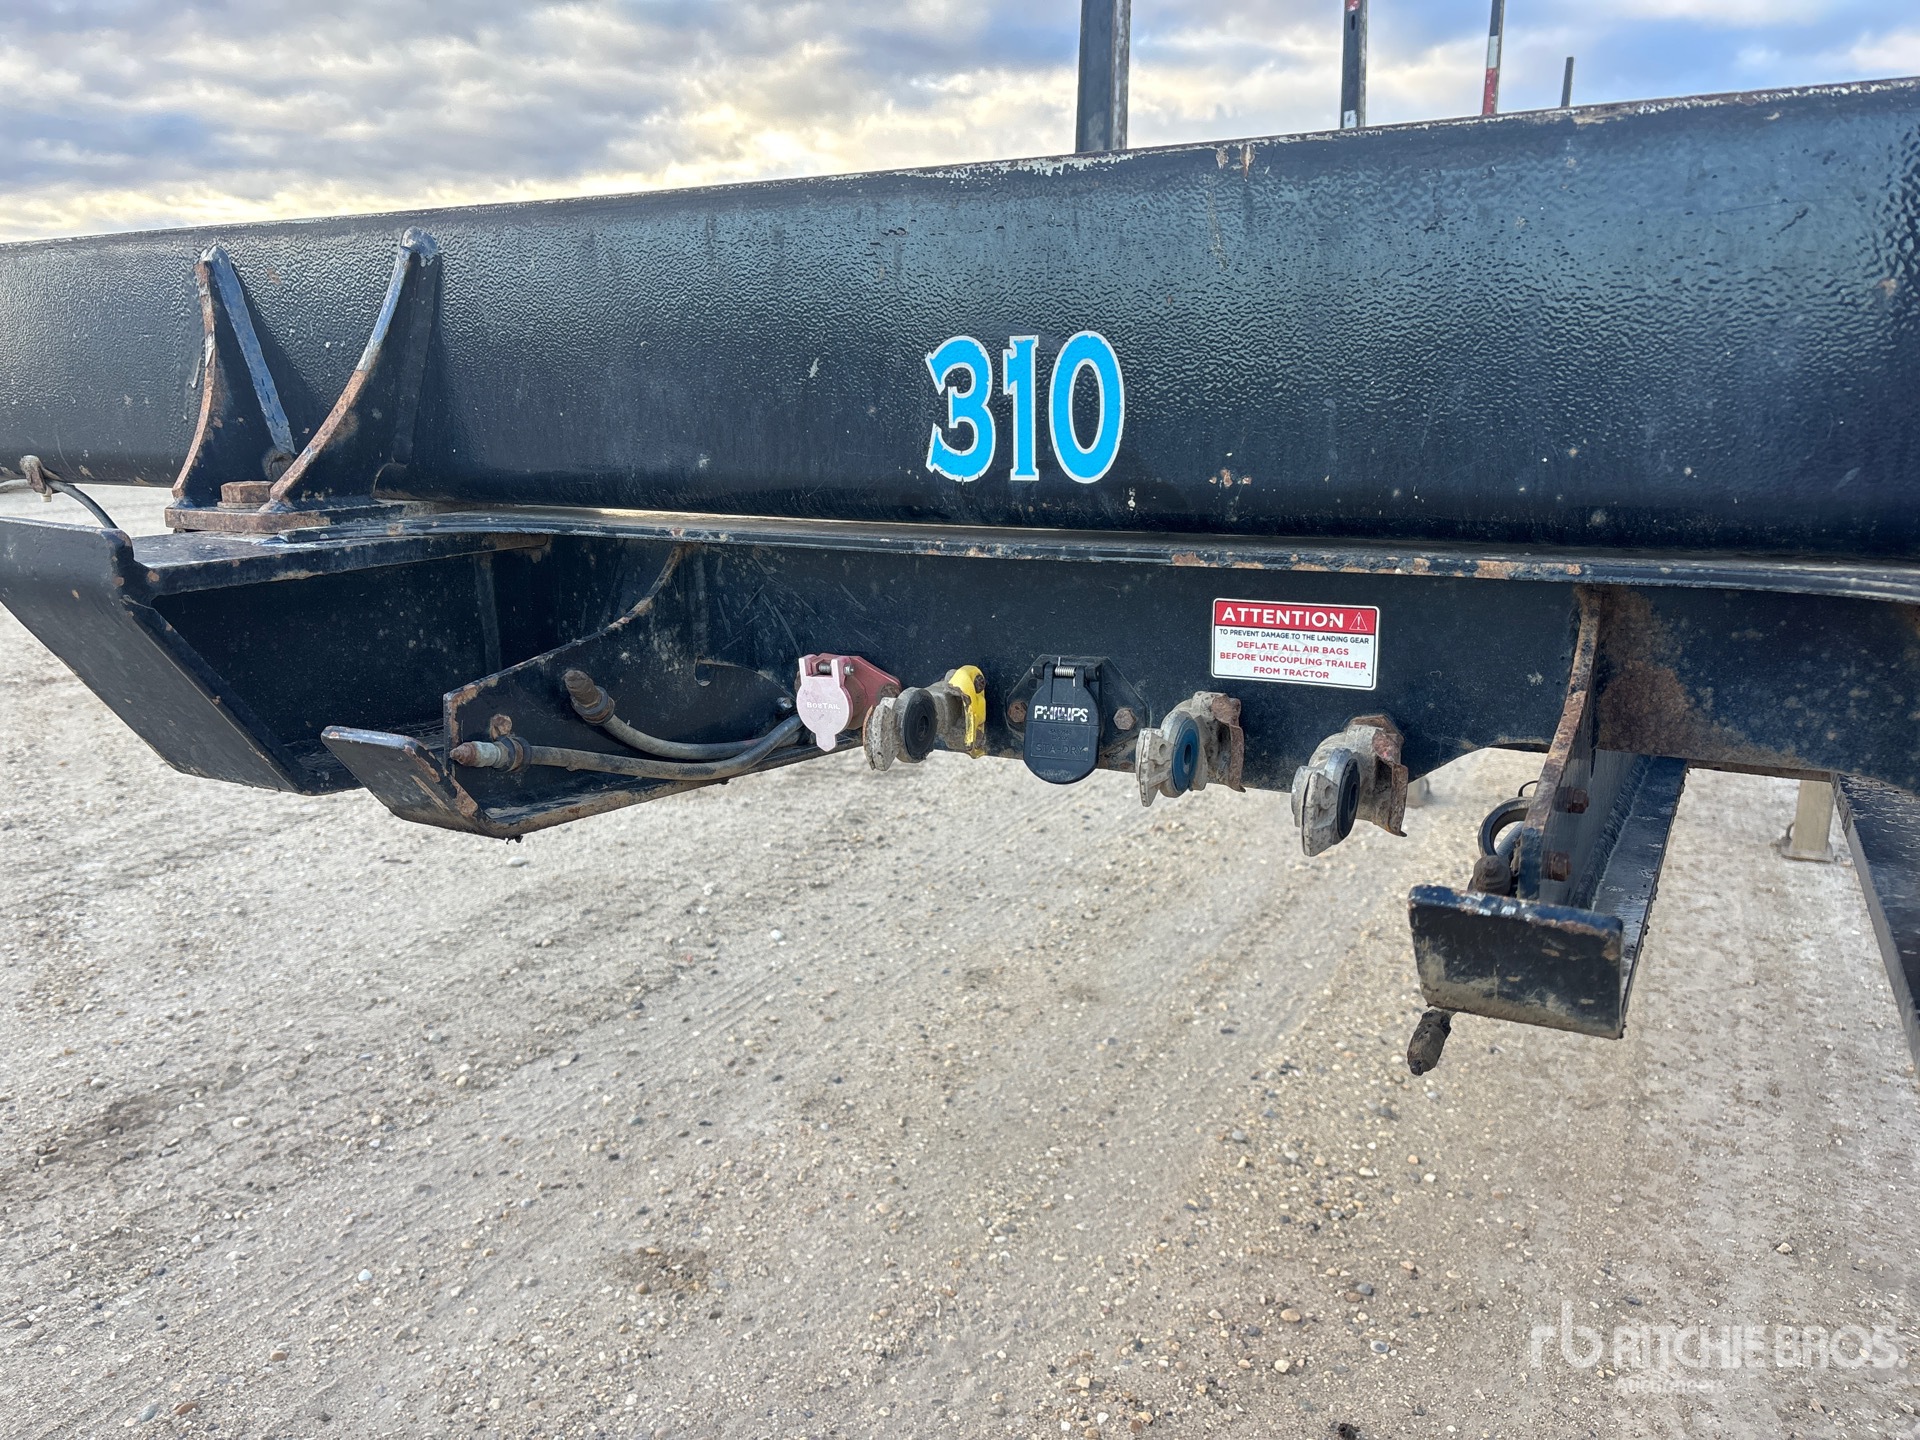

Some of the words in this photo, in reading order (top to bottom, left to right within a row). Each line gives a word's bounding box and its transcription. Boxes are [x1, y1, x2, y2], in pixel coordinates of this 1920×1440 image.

[925, 330, 1125, 485] 310
[1221, 606, 1344, 629] ATTENTION
[1219, 628, 1229, 636] TO
[1229, 629, 1260, 638] PREVENT
[1260, 631, 1290, 640] DAMAGE
[1291, 633, 1301, 641] TO
[1302, 633, 1316, 641] THE
[1316, 635, 1349, 644] LANDING
[1349, 636, 1370, 645] GEAR
[1236, 640, 1279, 651] DEFLATE
[1281, 644, 1301, 653] ALL
[1302, 645, 1320, 654] AIR
[1322, 646, 1350, 656] BAGS
[1219, 651, 1257, 662] BEFORE
[1258, 654, 1323, 667] UNCOUPLING
[1324, 659, 1368, 670] TRAILER
[1253, 666, 1281, 675] FROM
[1282, 668, 1330, 679] TRACTOR
